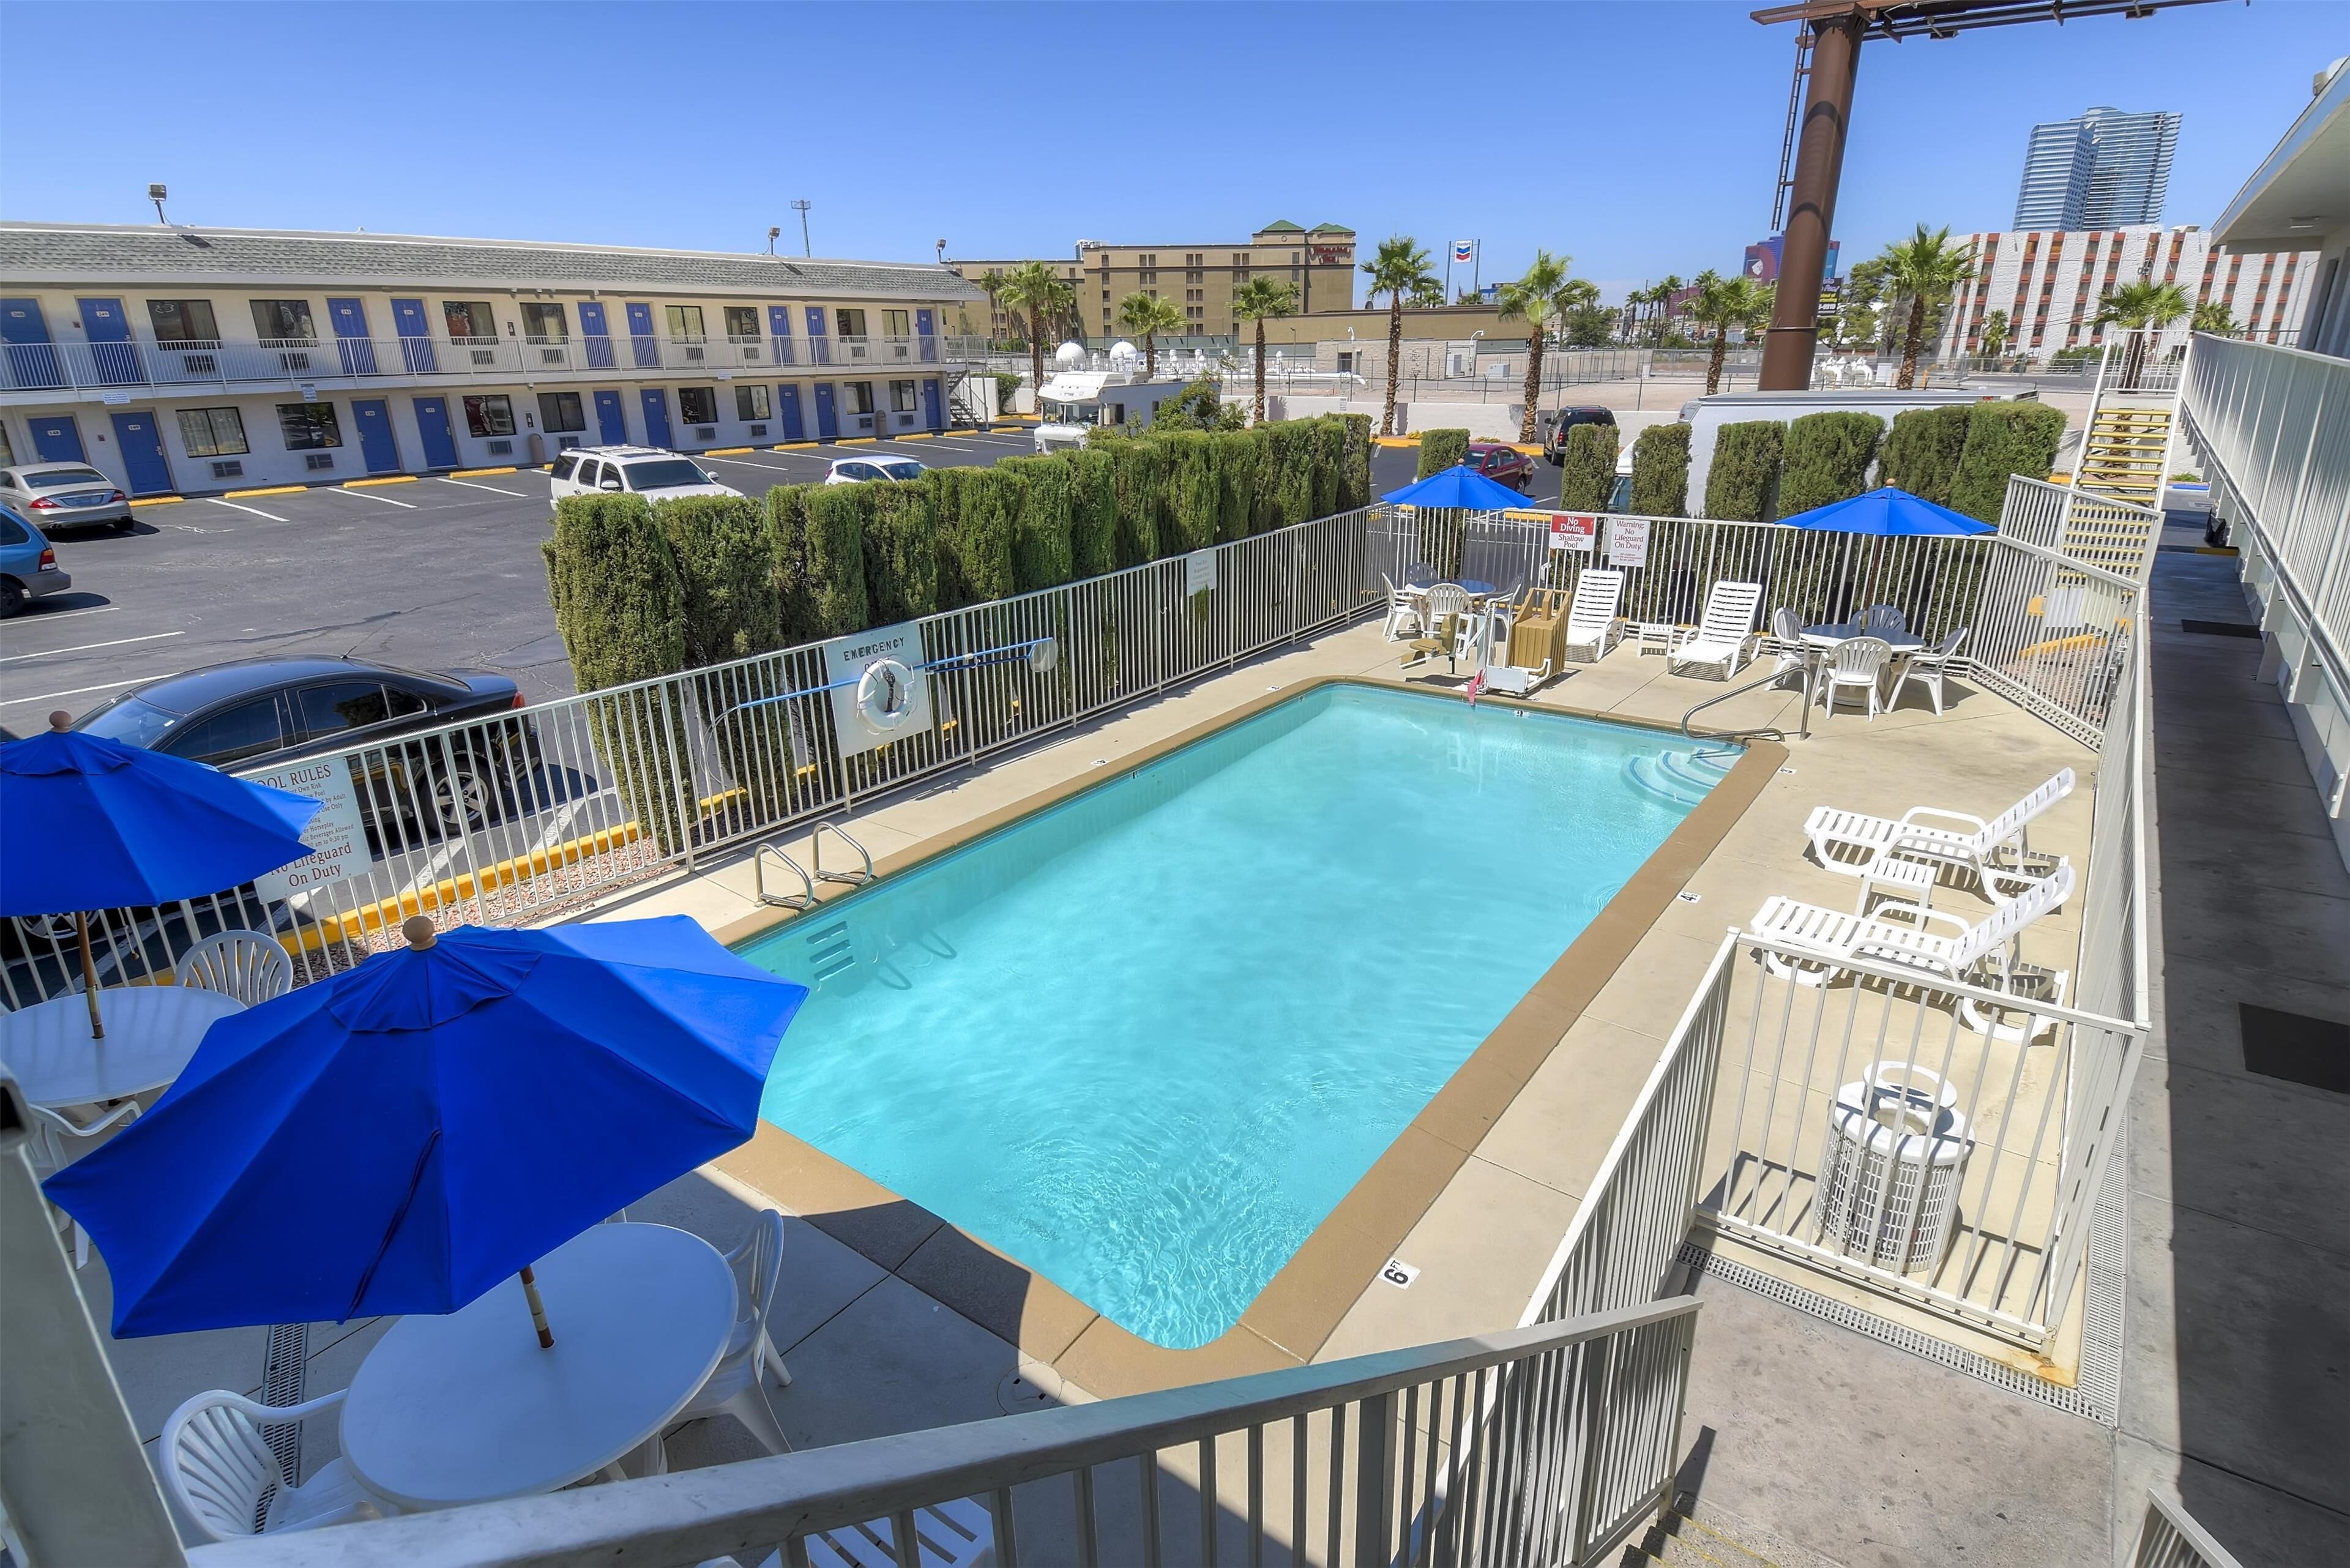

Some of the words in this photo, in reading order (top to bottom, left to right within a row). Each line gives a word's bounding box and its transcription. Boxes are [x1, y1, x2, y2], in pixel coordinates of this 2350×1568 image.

[1560, 524, 1585, 534] Diving
[1558, 534, 1584, 542] Shallow
[1614, 534, 1644, 543] Lifeguard
[843, 637, 905, 661] EMERGENCY
[289, 764, 332, 785] RULES
[331, 802, 343, 811] Only
[310, 822, 334, 832] Horseplay
[310, 831, 334, 840] Beverages
[335, 824, 354, 834] Allowed
[289, 873, 308, 887] On
[311, 864, 341, 881] Duty
[1390, 1260, 1401, 1269] FT
[1384, 1268, 1409, 1285] 6
